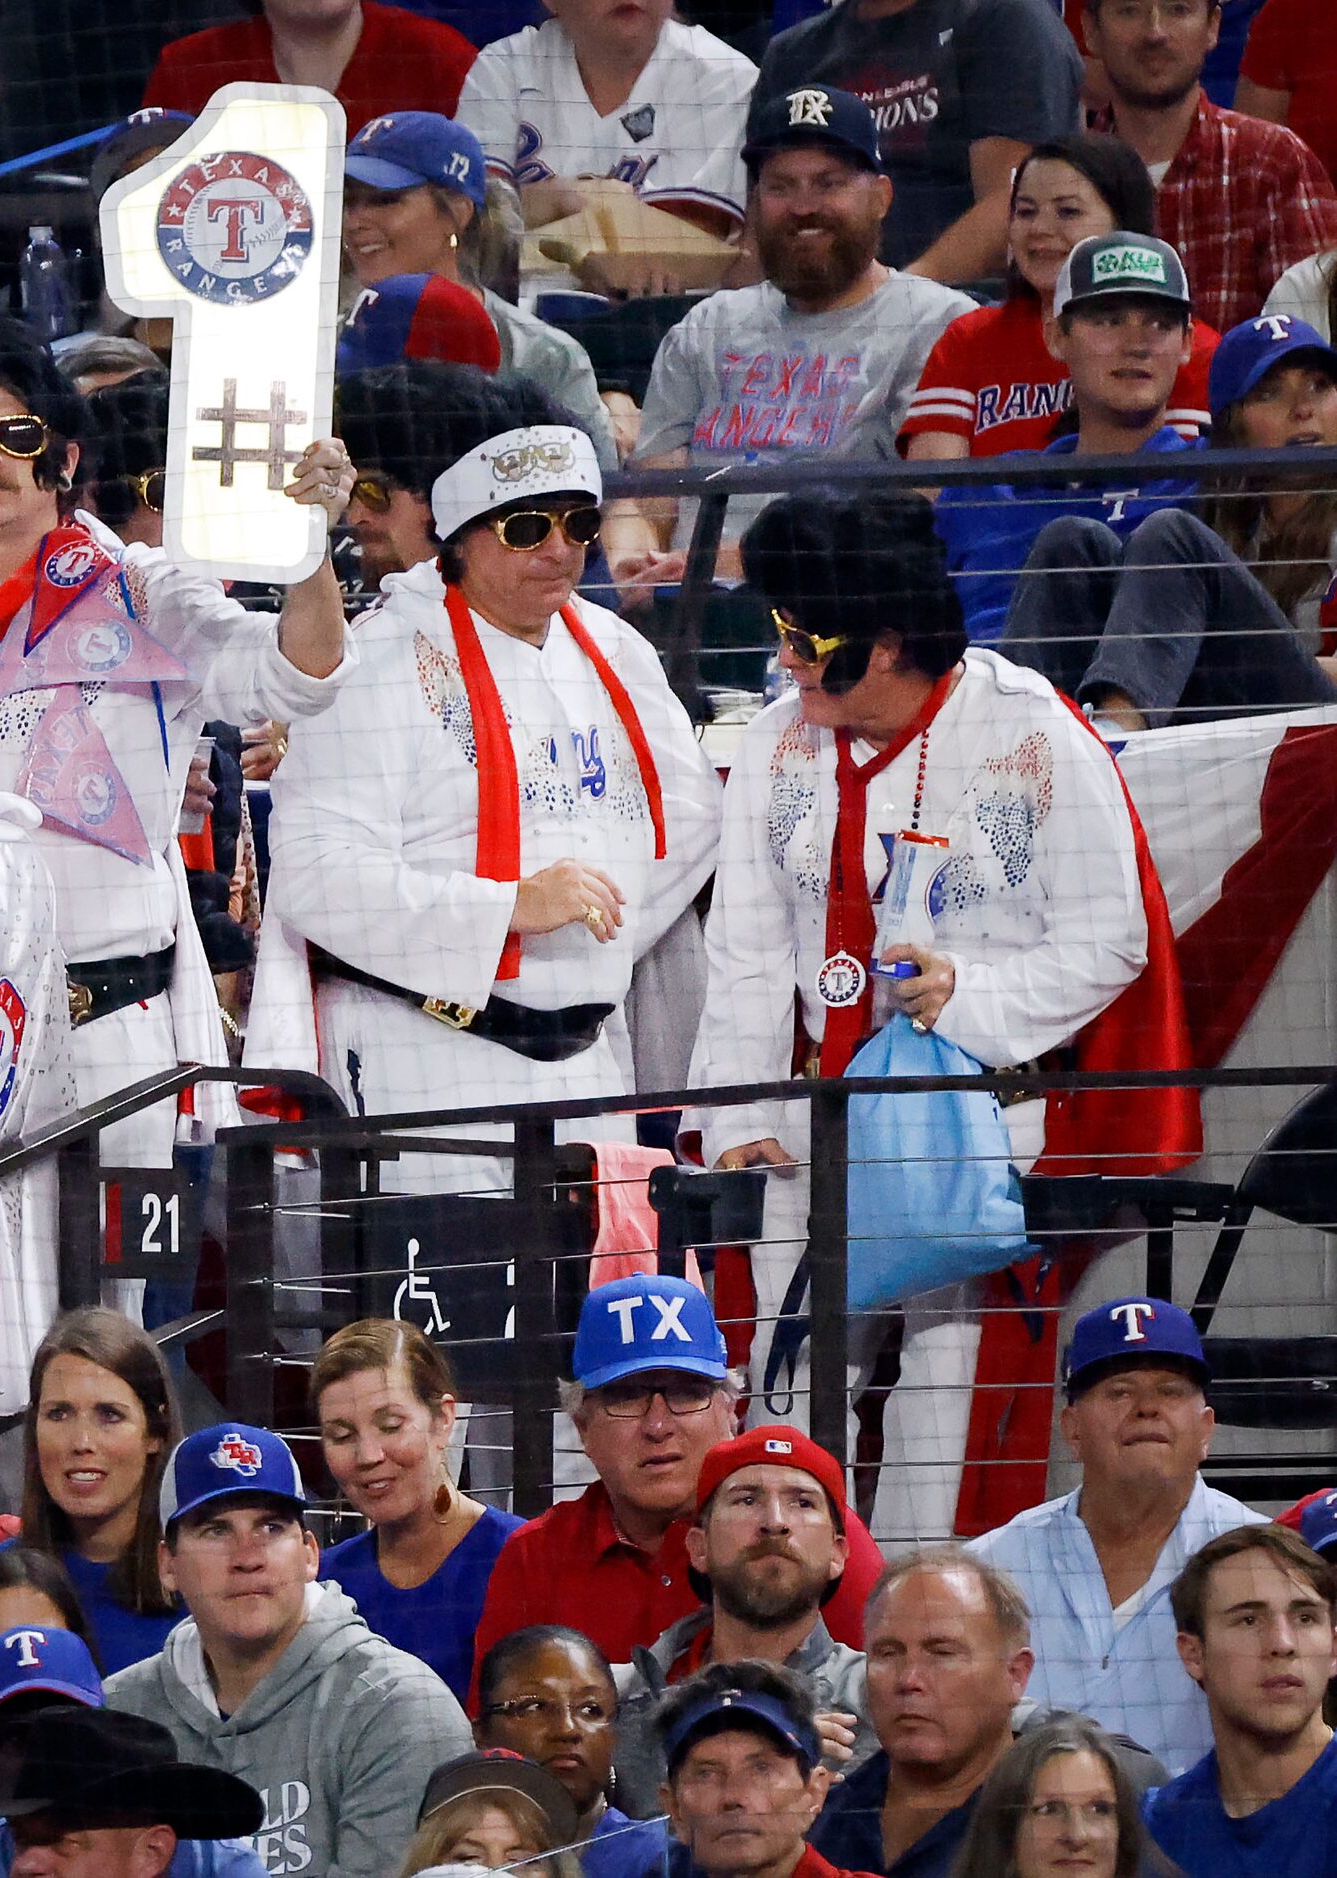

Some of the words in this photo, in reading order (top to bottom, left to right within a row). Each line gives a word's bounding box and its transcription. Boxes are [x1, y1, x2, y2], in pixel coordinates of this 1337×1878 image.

[178, 158, 294, 198] TEXAS
[207, 199, 264, 263] T
[166, 237, 306, 298] RANGE
[1254, 315, 1291, 340] T
[723, 353, 859, 400] TEXAS
[974, 380, 1073, 436] RAN
[192, 378, 308, 490] #
[1102, 488, 1139, 521] T
[141, 1192, 179, 1253] 21
[607, 1295, 693, 1344] TX
[1109, 1303, 1155, 1342] T
[4, 1631, 48, 1668] T
